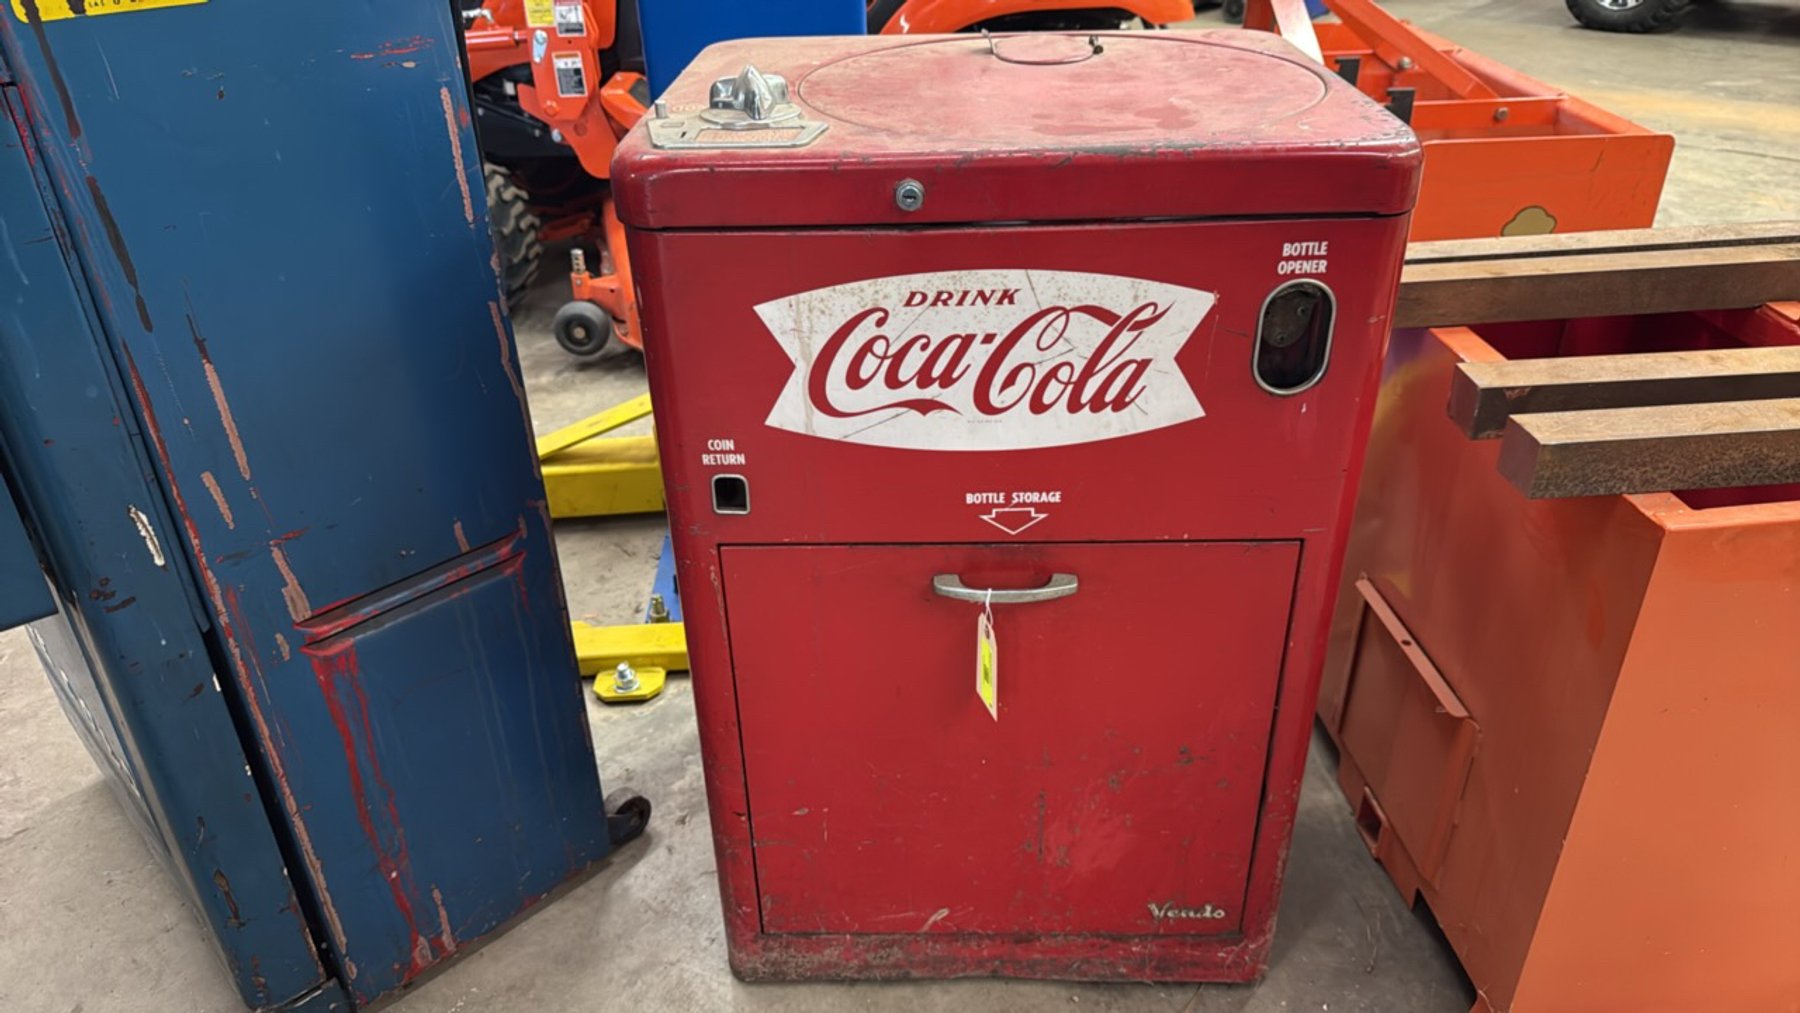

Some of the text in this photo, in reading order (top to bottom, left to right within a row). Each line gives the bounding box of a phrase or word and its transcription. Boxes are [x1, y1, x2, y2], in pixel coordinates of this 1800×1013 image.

[1282, 241, 1329, 257] BOTTLE
[1277, 259, 1328, 275] OPENER
[903, 288, 1020, 308] DRINK
[808, 300, 1177, 418] Coca-Cola
[707, 438, 735, 451] COIN
[701, 453, 746, 466] RETURN
[965, 491, 1062, 505] BOTTLE STORAGE
[1147, 901, 1226, 920] Vendo
